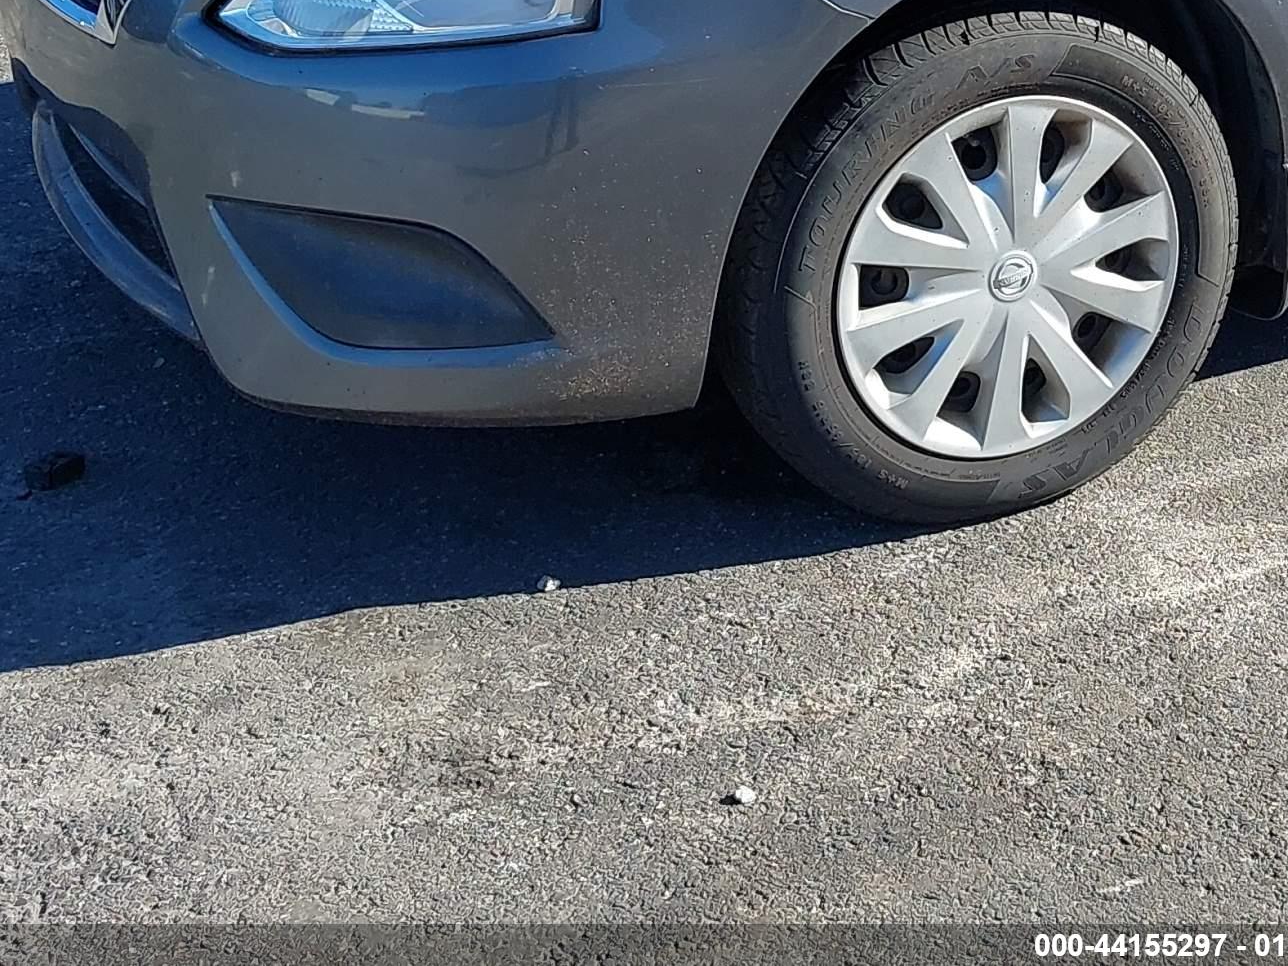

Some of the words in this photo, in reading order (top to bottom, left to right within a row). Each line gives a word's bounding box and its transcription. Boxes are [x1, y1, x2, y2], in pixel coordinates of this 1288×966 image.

[1120, 75, 1149, 98] M+S
[798, 92, 936, 275] TOURING
[955, 54, 1037, 90] A/S
[1019, 302, 1202, 499] DOUGLAS
[877, 468, 910, 490] M+S
